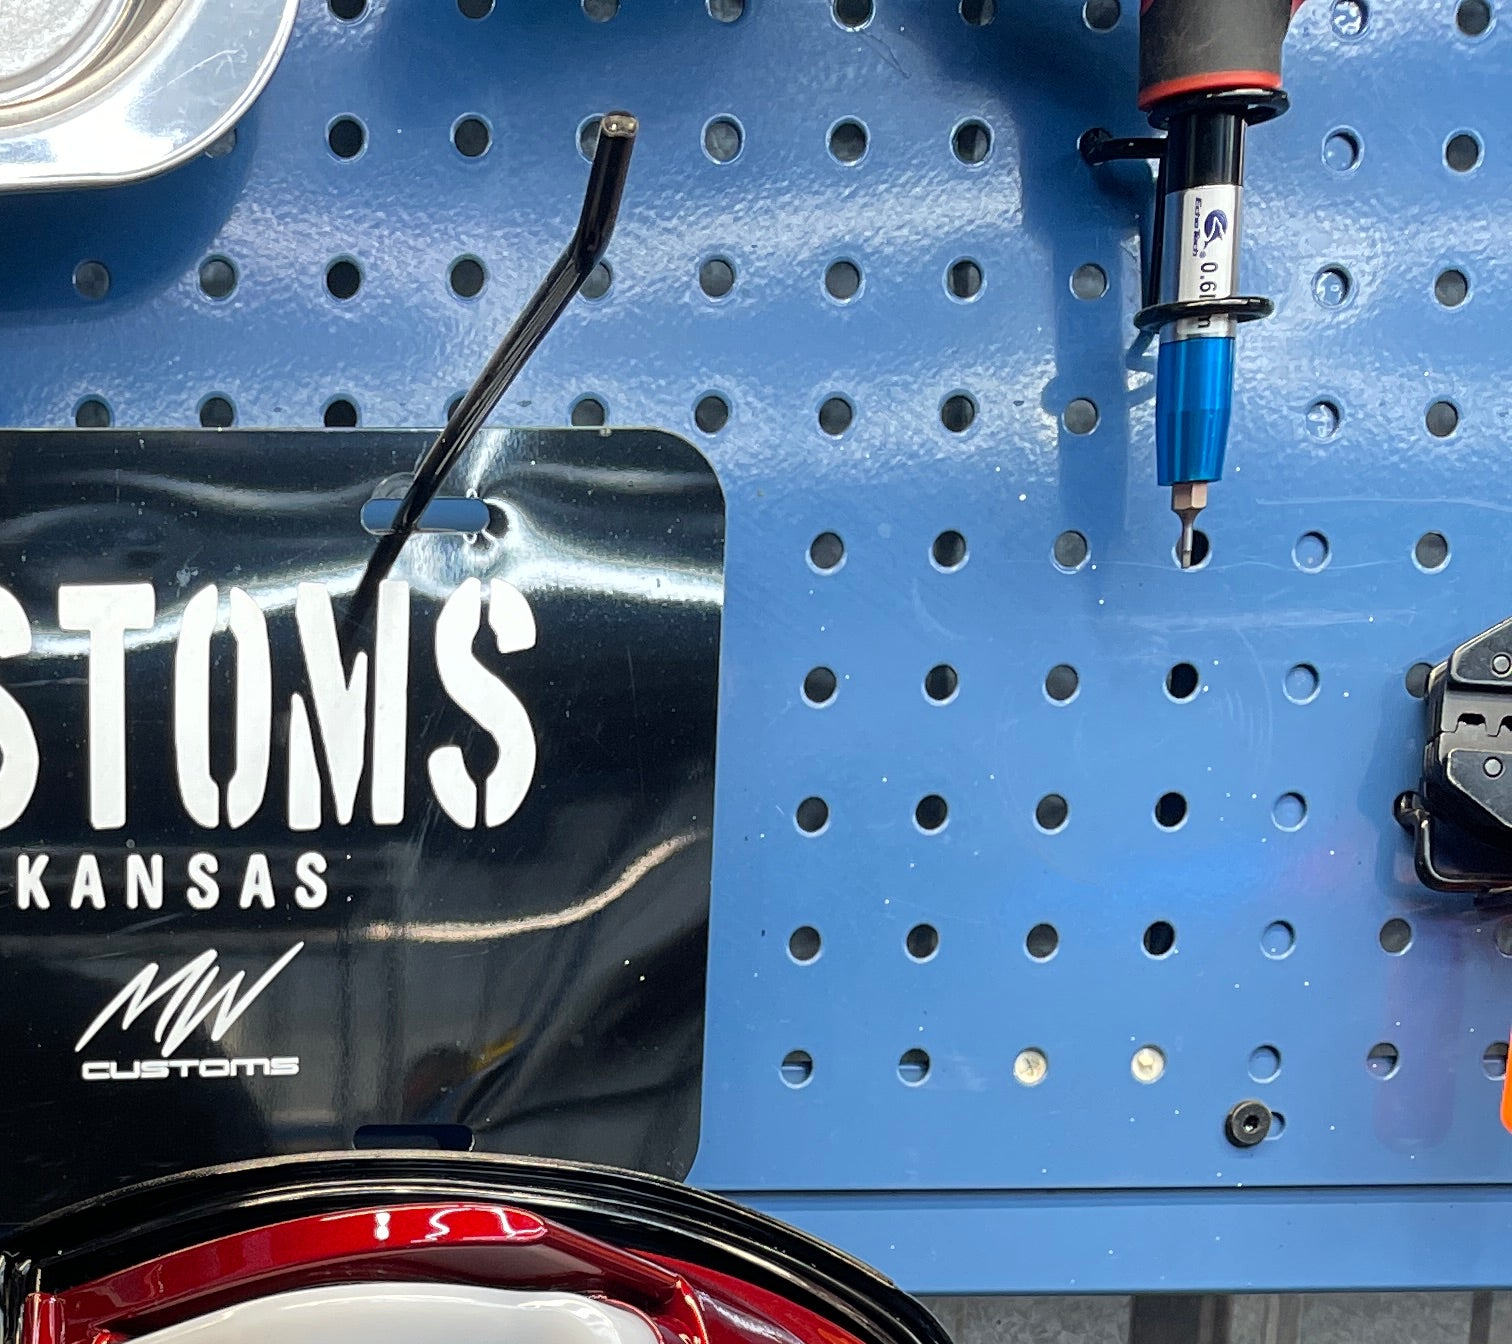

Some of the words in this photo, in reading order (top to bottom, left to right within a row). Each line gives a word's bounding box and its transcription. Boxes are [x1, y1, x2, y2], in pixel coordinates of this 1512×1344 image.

[16, 851, 330, 911] KANSAS
[74, 940, 306, 1058] MW
[81, 1055, 301, 1081] CUSTOMS
